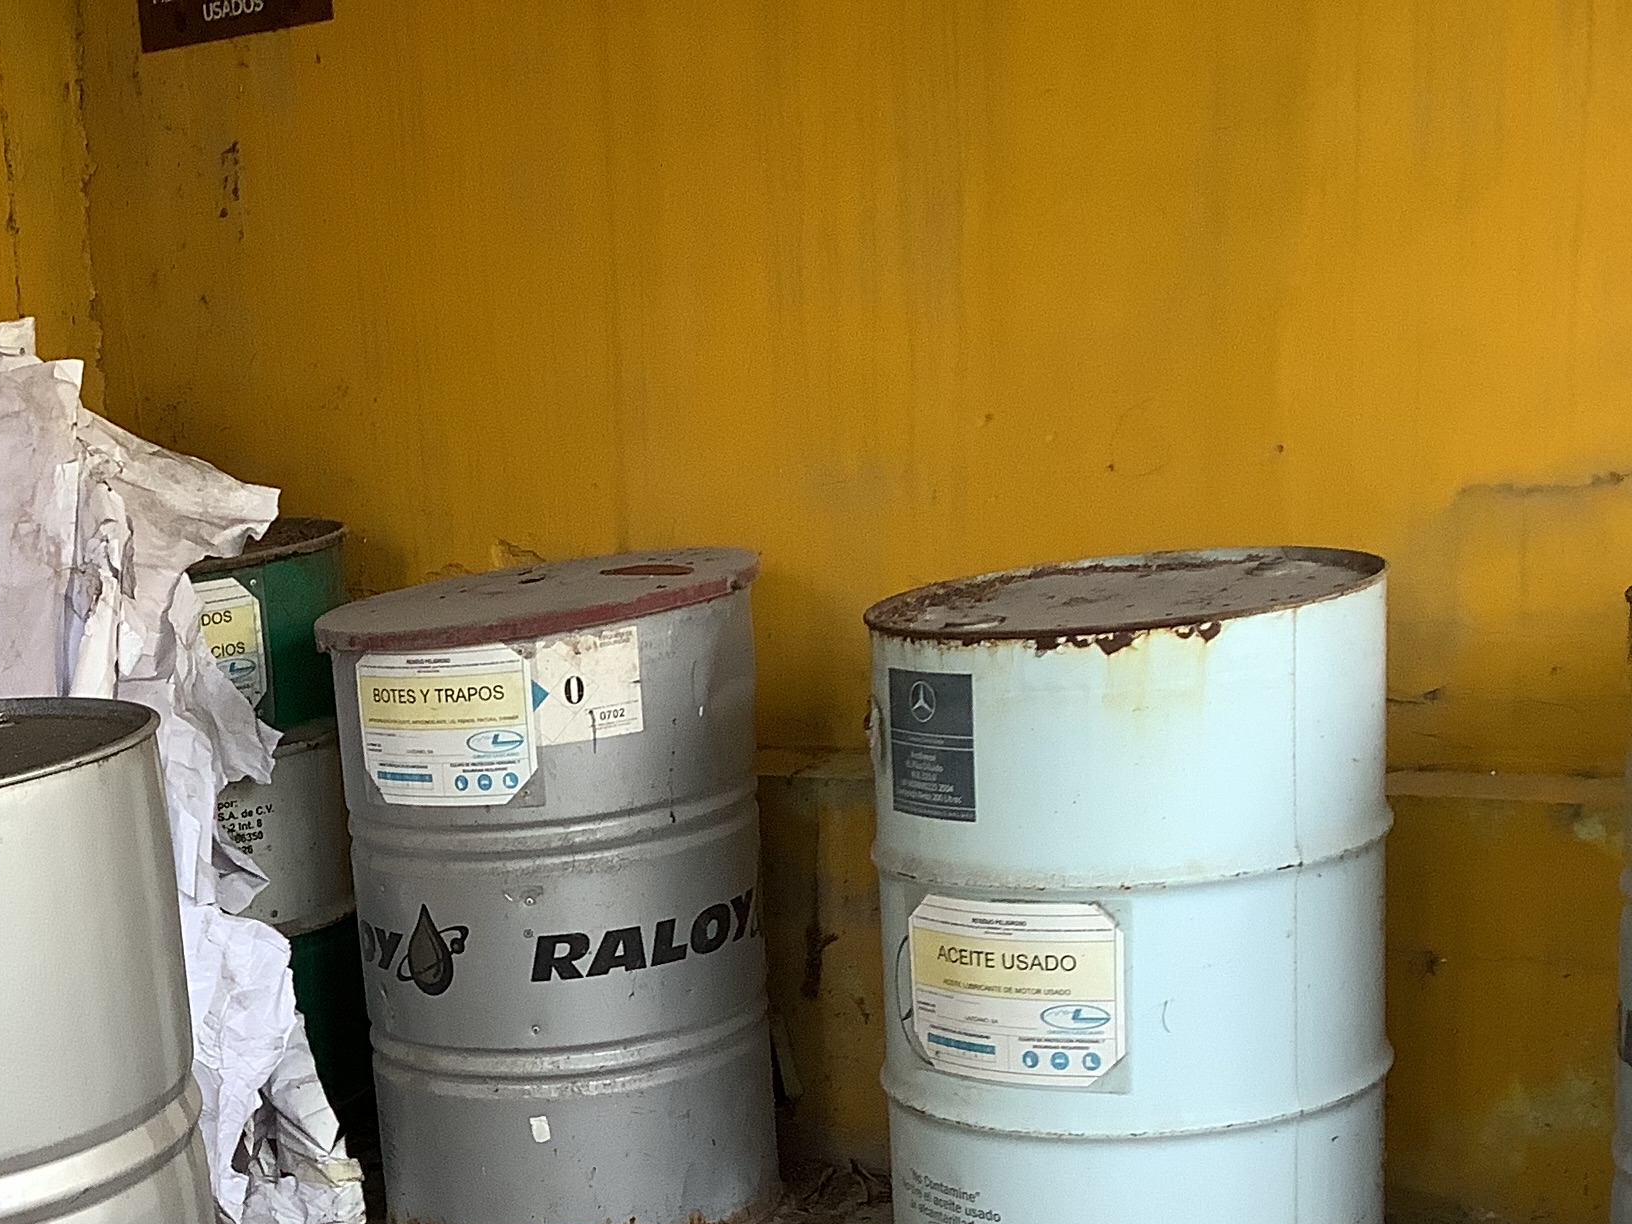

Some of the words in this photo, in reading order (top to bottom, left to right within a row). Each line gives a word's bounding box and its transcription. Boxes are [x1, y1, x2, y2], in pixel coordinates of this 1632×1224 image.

[203, 0, 264, 21] USADOS
[373, 688, 416, 704] BOTES
[419, 689, 430, 703] Y
[434, 685, 505, 703] TRAPOS
[564, 675, 584, 704] 0
[599, 708, 625, 720] 0702
[217, 811, 239, 821] S.A.
[241, 809, 253, 818] de
[256, 804, 274, 815] C.V.
[238, 821, 254, 831] Int.
[360, 920, 403, 970] OY
[531, 888, 753, 982] RALOY
[937, 945, 995, 968] ACEITE
[1002, 953, 1077, 971] USADO
[962, 982, 1002, 993] LUBRICANTE
[1003, 986, 1013, 994] DE
[1015, 987, 1042, 995] MOTOR
[1043, 988, 1071, 996] USADO
[933, 1196, 962, 1214] aceite
[964, 1206, 1002, 1223] usado
